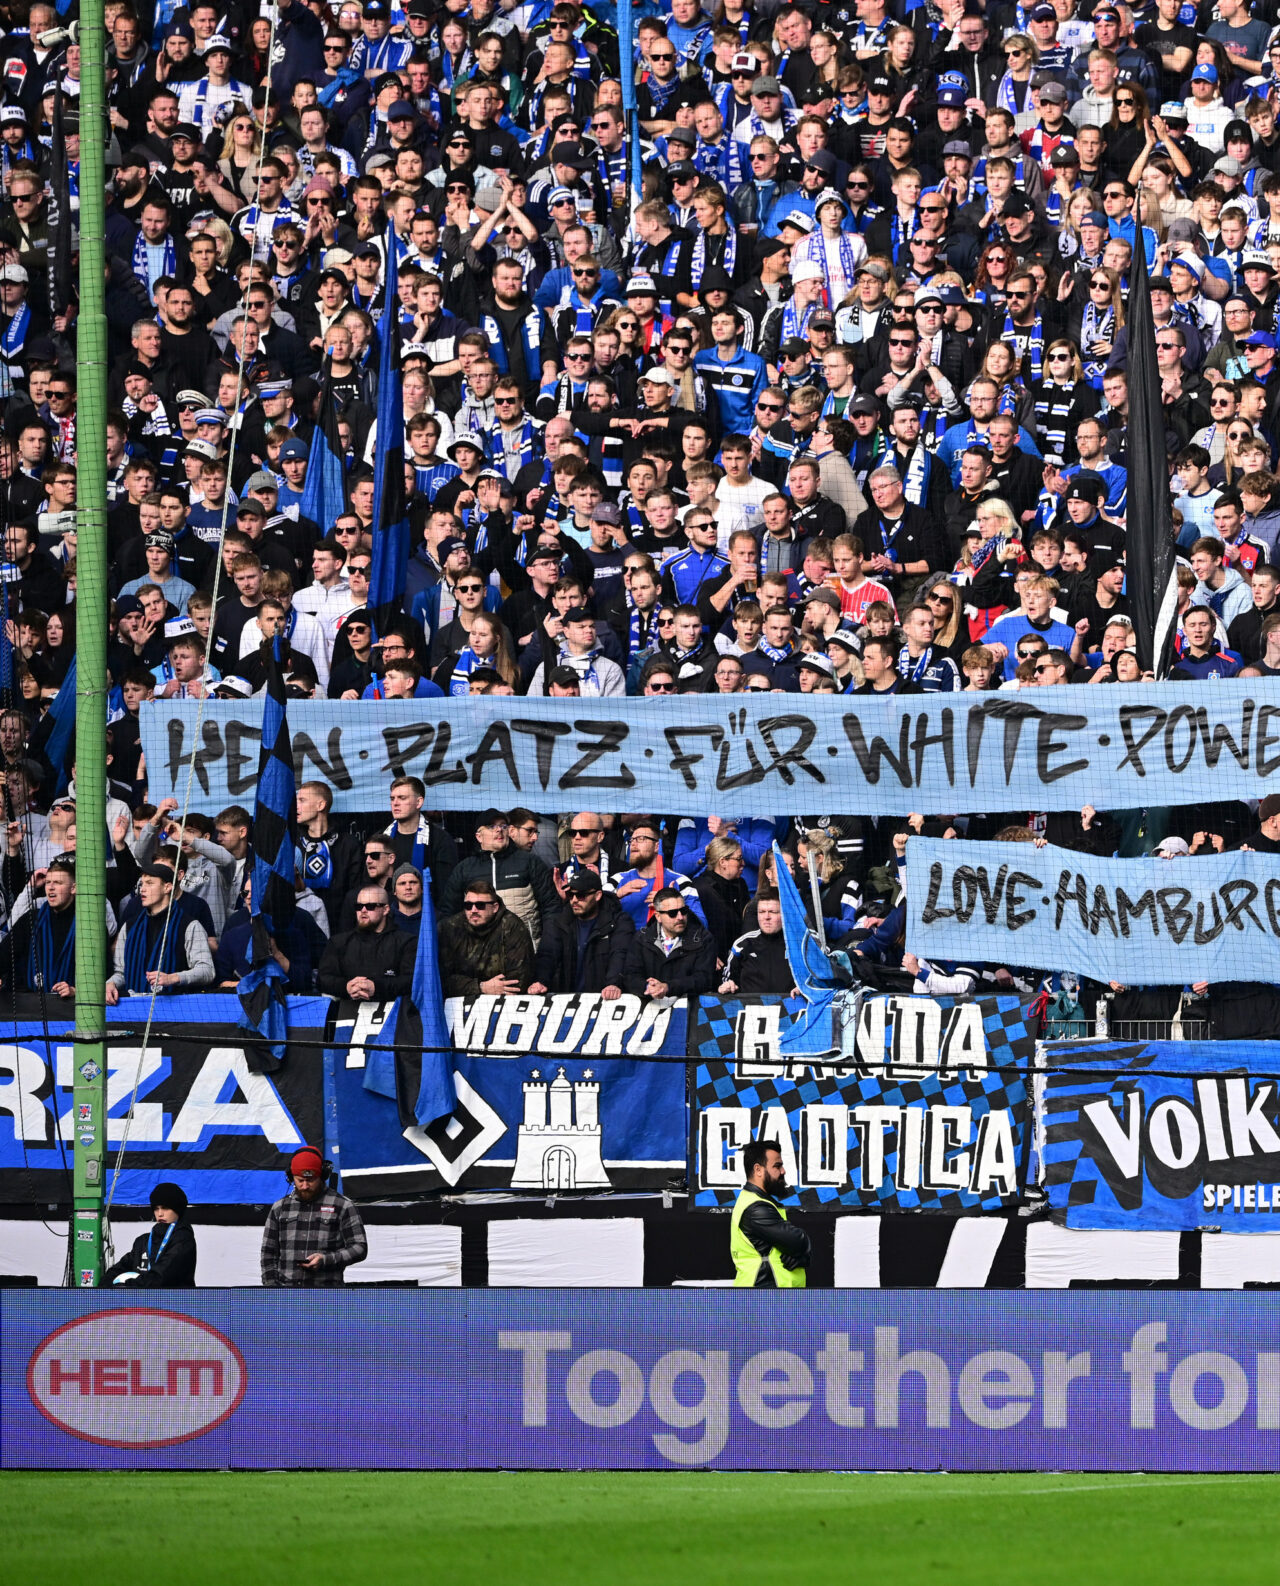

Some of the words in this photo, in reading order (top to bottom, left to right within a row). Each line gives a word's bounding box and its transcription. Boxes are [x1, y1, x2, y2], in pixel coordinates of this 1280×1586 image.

[7, 109, 24, 117] HSV
[164, 719, 352, 796] KEN
[381, 717, 636, 790] PLATZ
[664, 706, 825, 790] FÜR
[848, 698, 1089, 789] WHITE
[922, 861, 1045, 930] LOVE
[344, 993, 672, 1069] HMBURG
[734, 995, 988, 1081] BNDA
[49, 1358, 224, 1398] HELM
[498, 1327, 1090, 1465] Together
